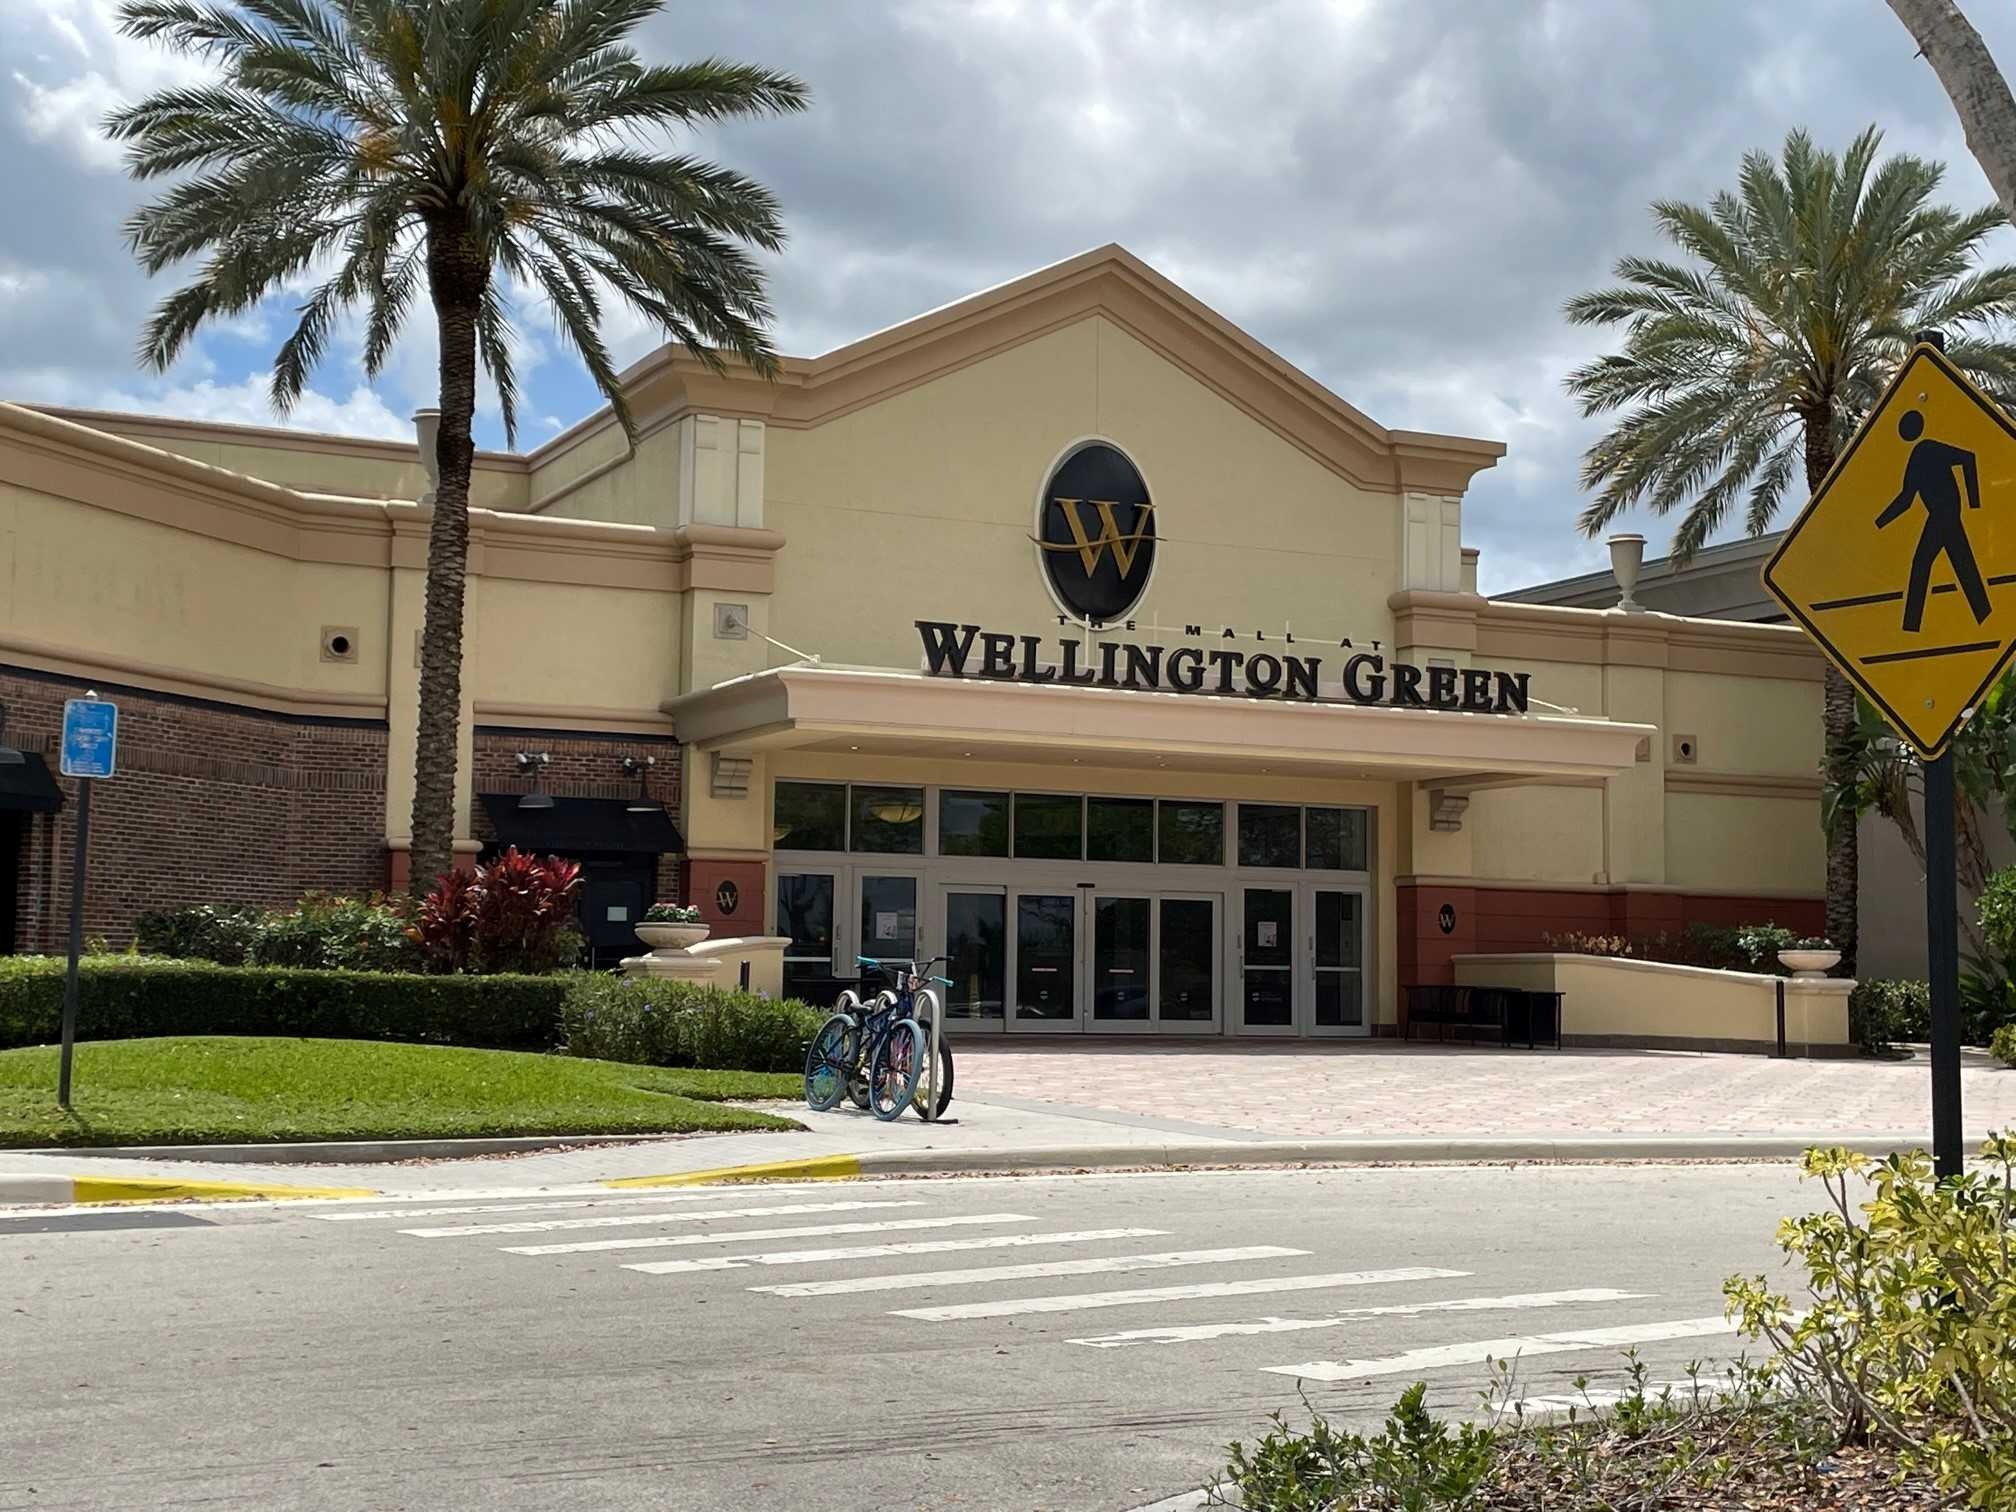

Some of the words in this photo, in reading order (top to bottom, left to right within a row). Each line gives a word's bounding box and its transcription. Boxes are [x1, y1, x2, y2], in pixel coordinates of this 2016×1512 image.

[1054, 497, 1156, 580] W
[1057, 615, 1136, 631] THE
[1185, 624, 1294, 643] MALL
[1340, 638, 1382, 650] AT
[915, 620, 1322, 697] WELLINGTON
[1343, 654, 1531, 713] GREEN
[718, 891, 736, 909] W
[1439, 912, 1455, 929] W
